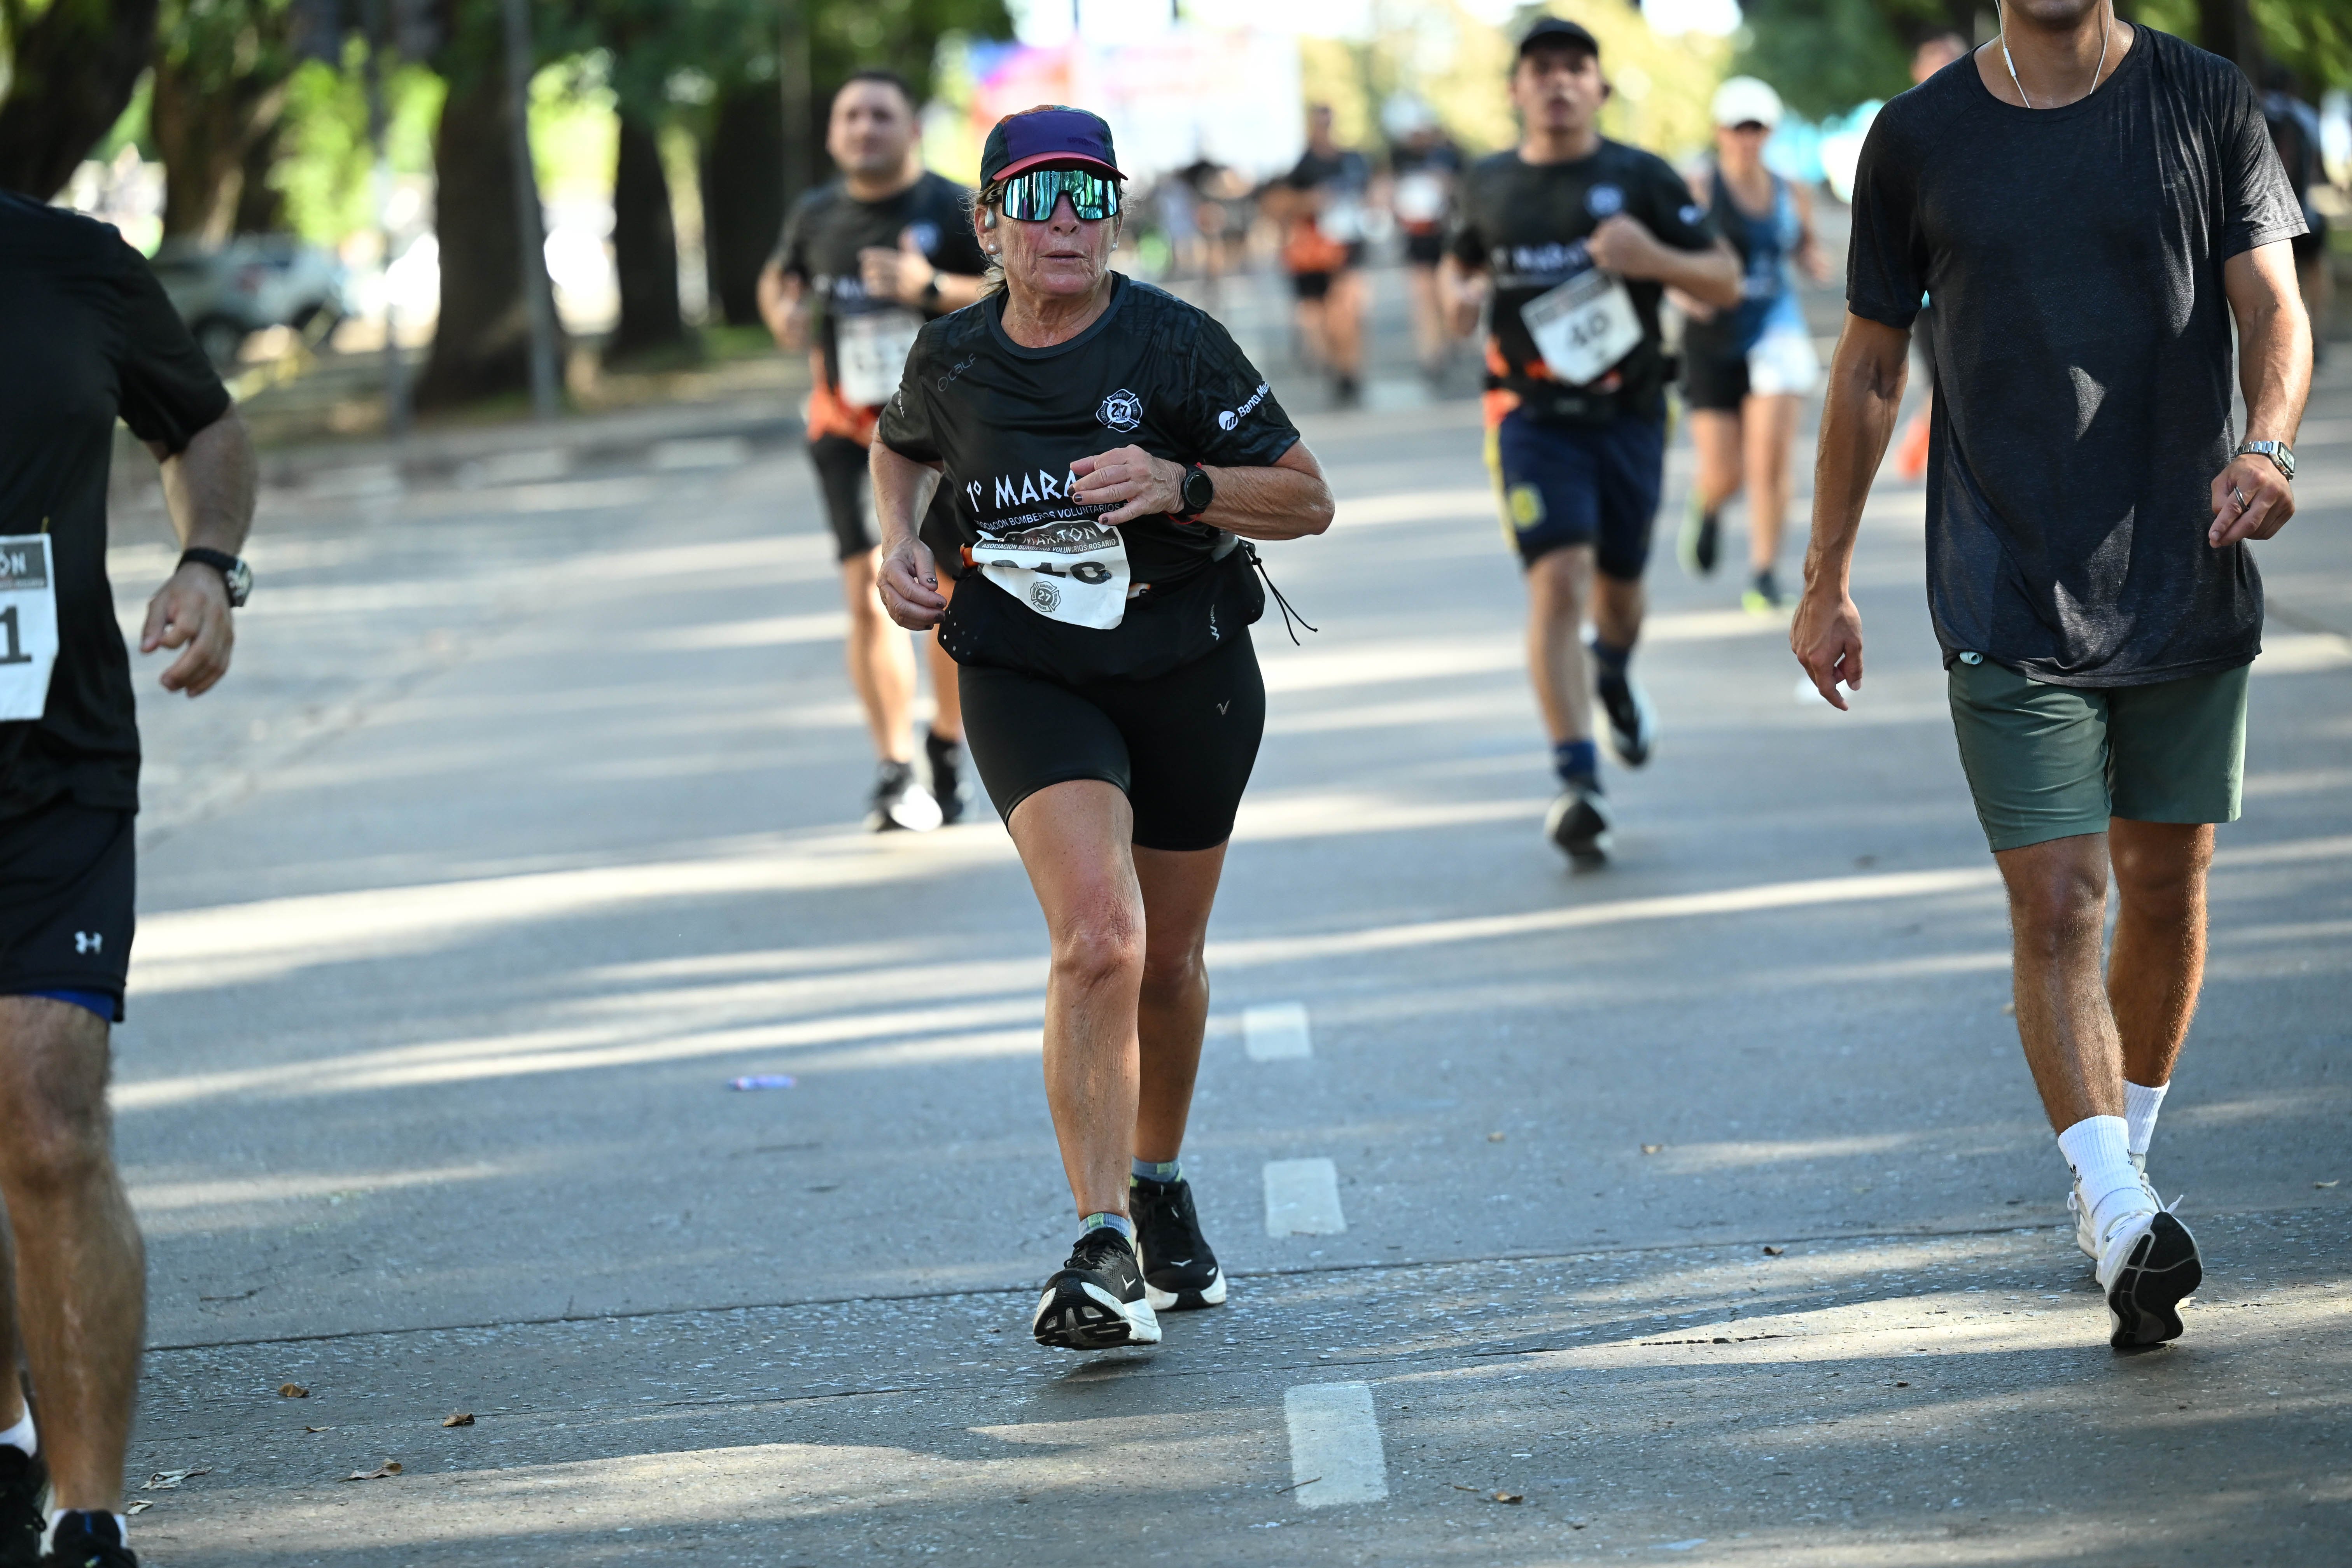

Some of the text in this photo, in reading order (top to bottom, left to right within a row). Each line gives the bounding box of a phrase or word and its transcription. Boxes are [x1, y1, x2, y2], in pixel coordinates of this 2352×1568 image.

[1111, 402, 1128, 418] 27
[1237, 394, 1261, 417] Banco
[1008, 511, 1056, 526] BOMBEROS
[1057, 503, 1120, 518] VOLUNTARIOS
[1089, 538, 1116, 550] ROSARIO
[1038, 590, 1051, 602] 27
